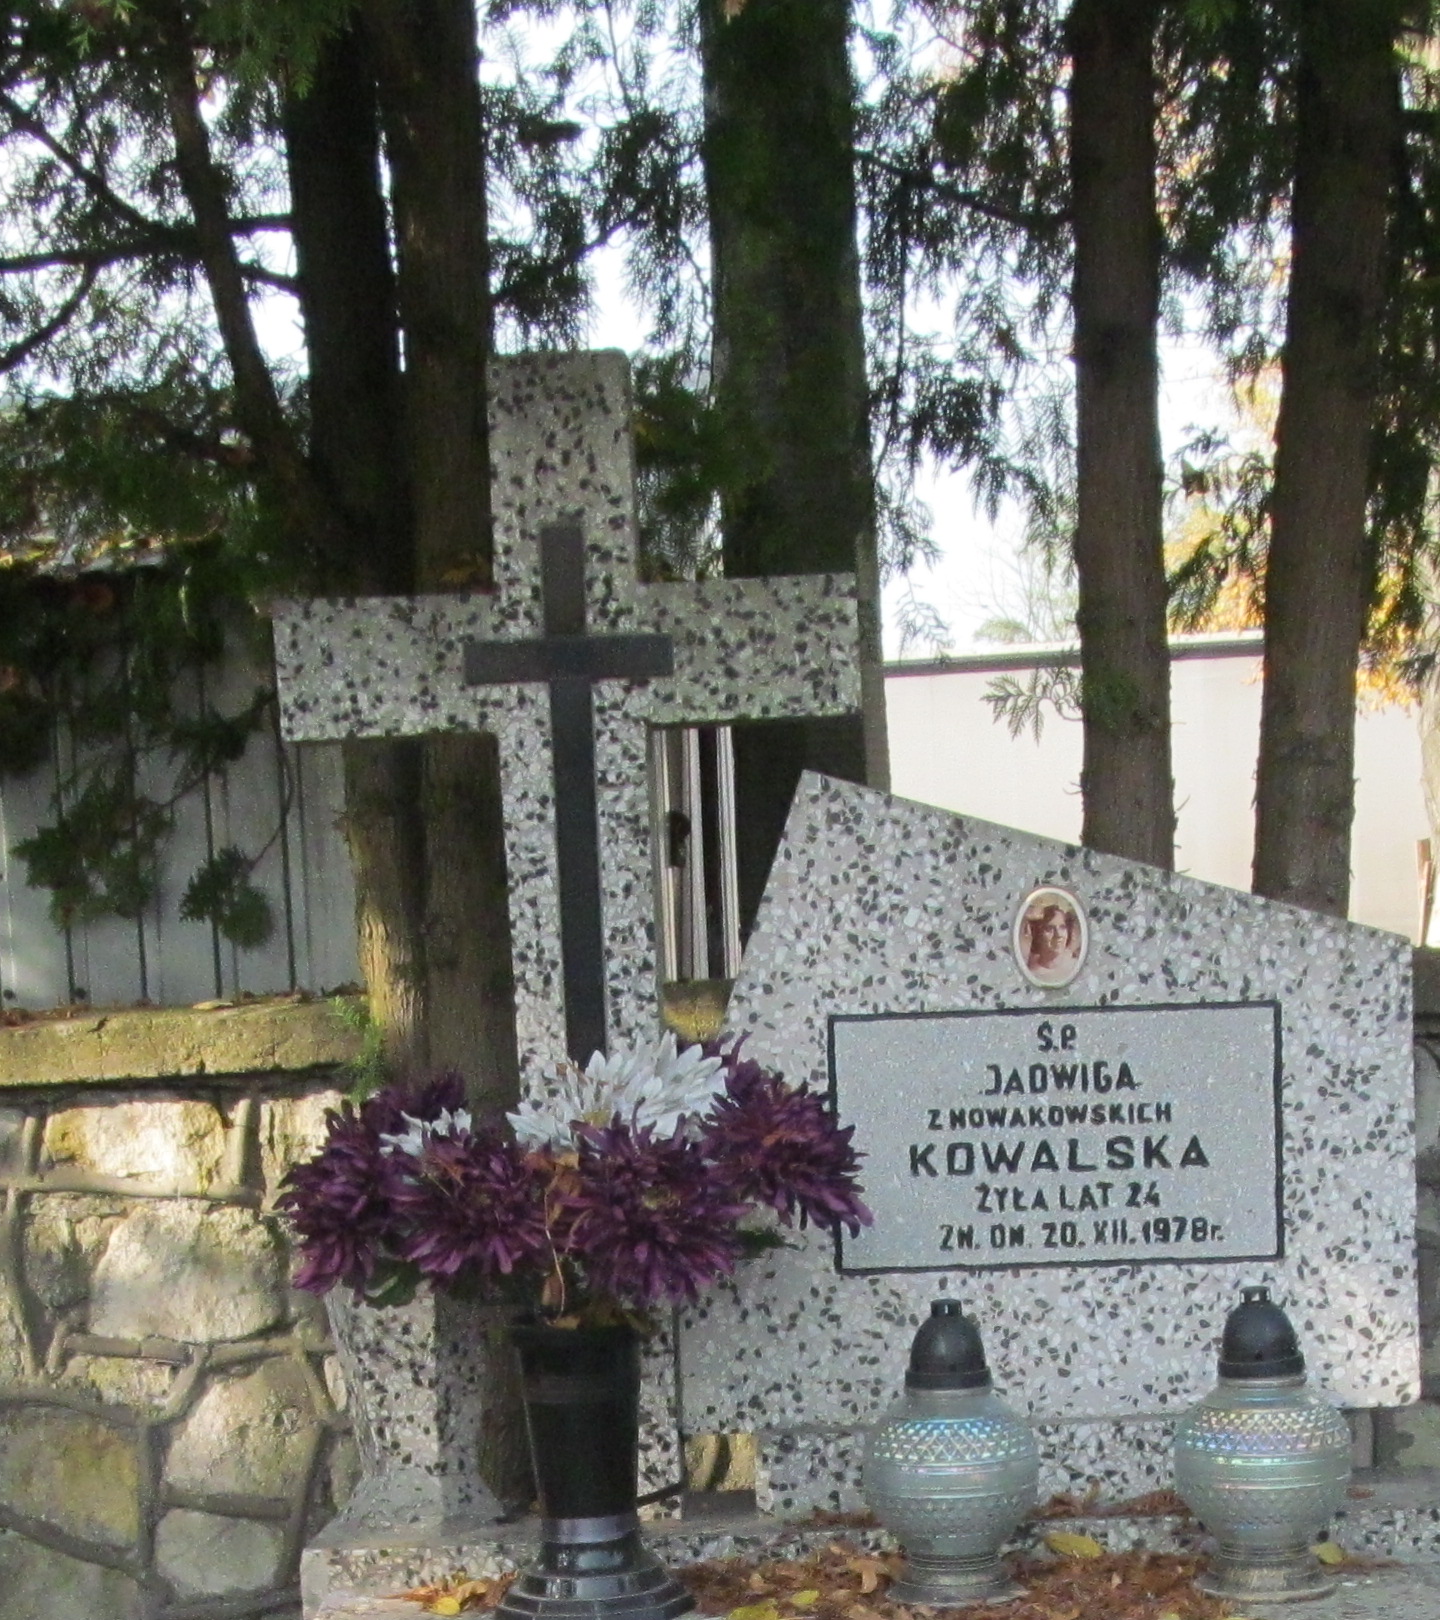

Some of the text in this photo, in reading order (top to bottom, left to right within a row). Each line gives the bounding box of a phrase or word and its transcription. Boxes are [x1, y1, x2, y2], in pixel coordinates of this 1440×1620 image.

[980, 1060, 1141, 1096] JADWIGA
[927, 1102, 1172, 1131] Z NOWAKOWSKICH
[910, 1134, 1210, 1178] KOWALSKA
[975, 1182, 1049, 1213] ŻYŁA
[1060, 1180, 1114, 1212] LAT
[1041, 1221, 1087, 1248] 20.
